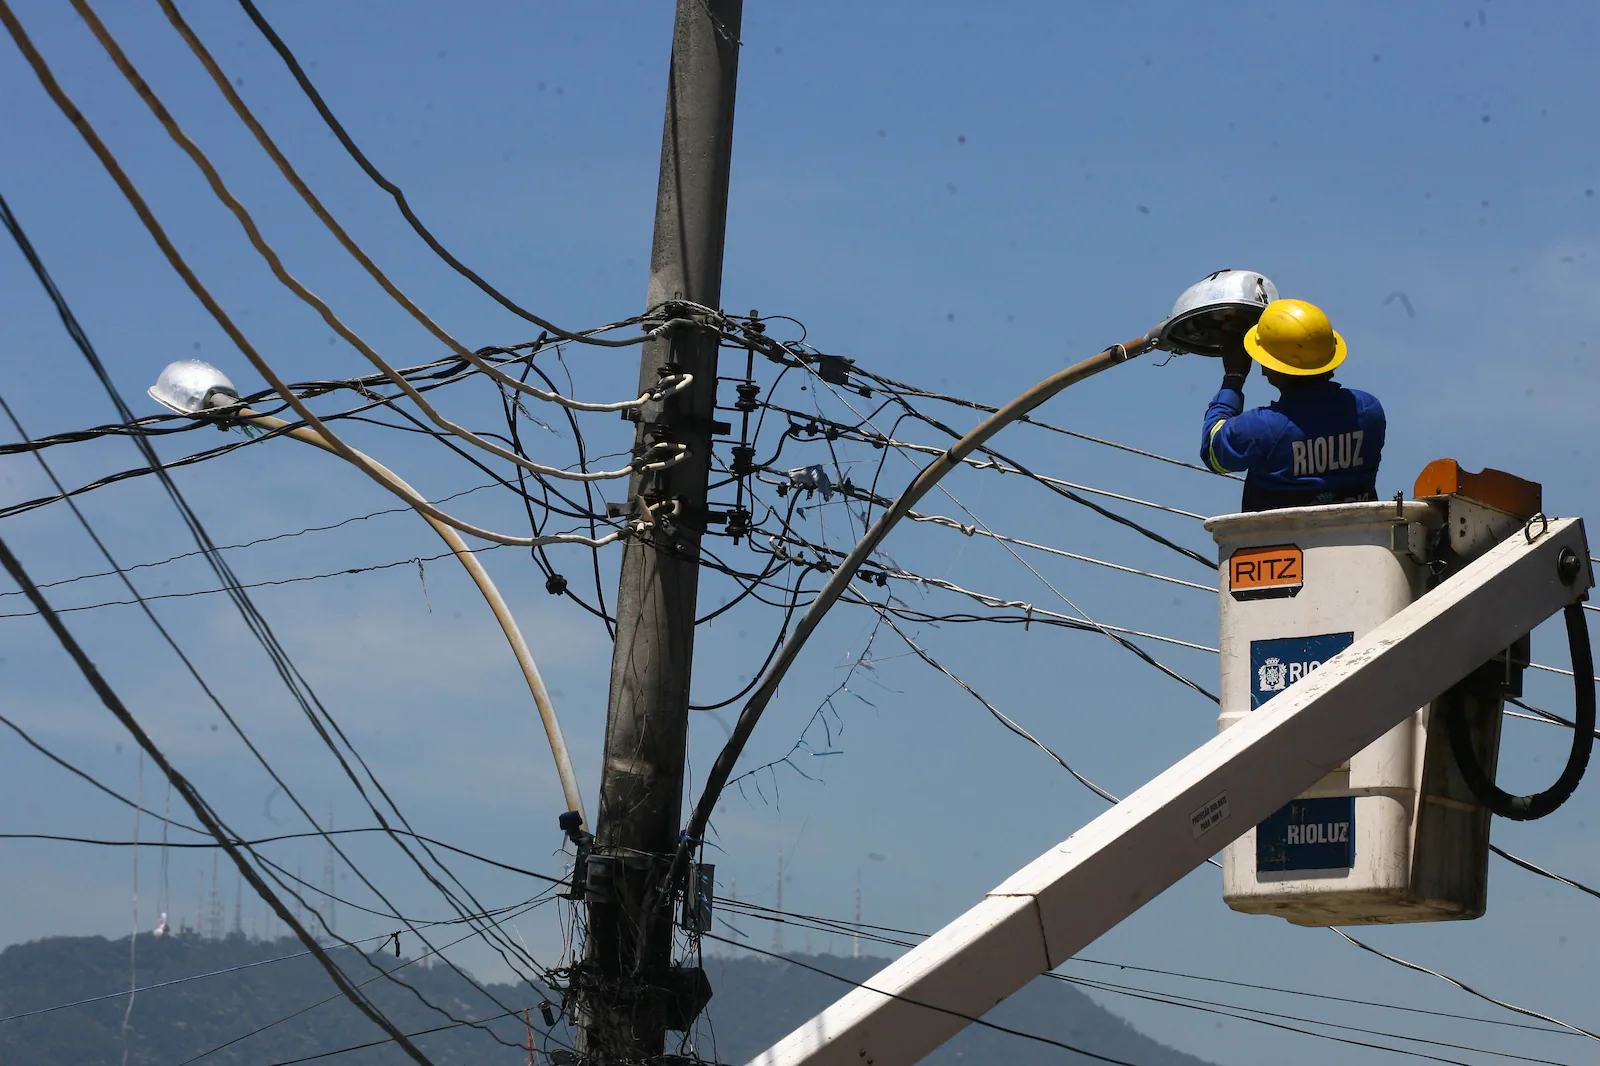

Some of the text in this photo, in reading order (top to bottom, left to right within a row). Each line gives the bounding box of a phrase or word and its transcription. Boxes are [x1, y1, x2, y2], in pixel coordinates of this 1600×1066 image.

[1291, 430, 1364, 476] RIOLUZ
[1236, 557, 1297, 583] RITZ
[1287, 821, 1350, 845] RIOLUZ
